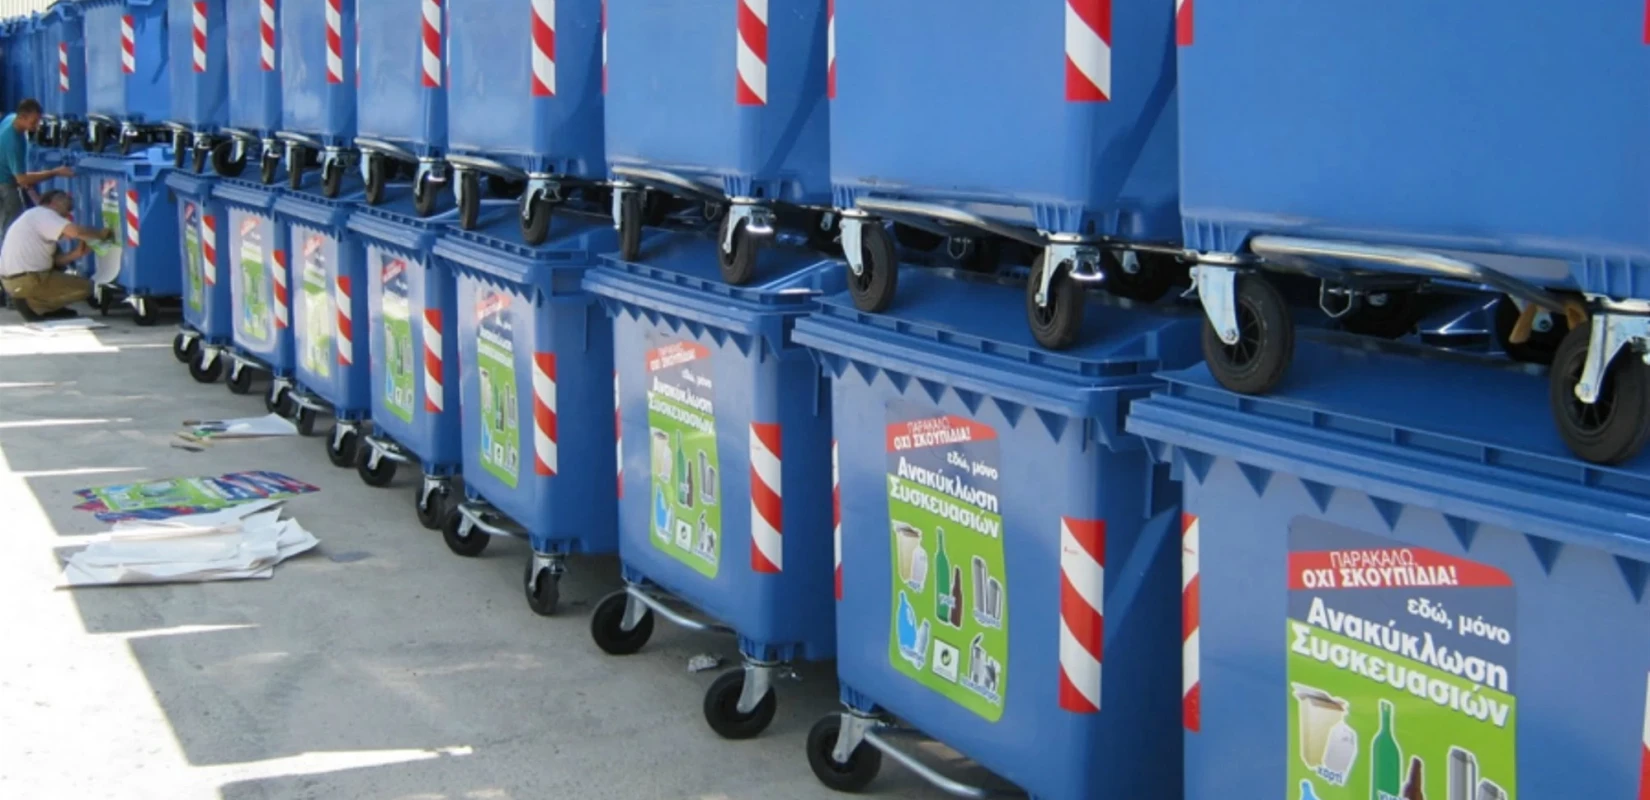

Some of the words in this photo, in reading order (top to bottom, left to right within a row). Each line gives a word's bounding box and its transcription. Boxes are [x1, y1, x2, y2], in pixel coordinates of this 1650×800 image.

[894, 434, 911, 450] ΟΧΙ
[914, 427, 971, 448] ΣΚΟΥΠΙΔΙΑ!
[897, 456, 999, 513] Ανακύκλωση
[972, 459, 998, 480] μόνο
[890, 477, 1000, 538] Συσκευασιών
[1302, 568, 1335, 588] ΟΧΙ
[1340, 565, 1458, 587] ΣΚΟΥΠΙΔΙΑ!
[1307, 597, 1509, 693] Ανακύκλωση
[1407, 596, 1452, 629] εδώ,
[1459, 613, 1510, 645] μόνο
[1291, 625, 1510, 727] Συσκευασιών
